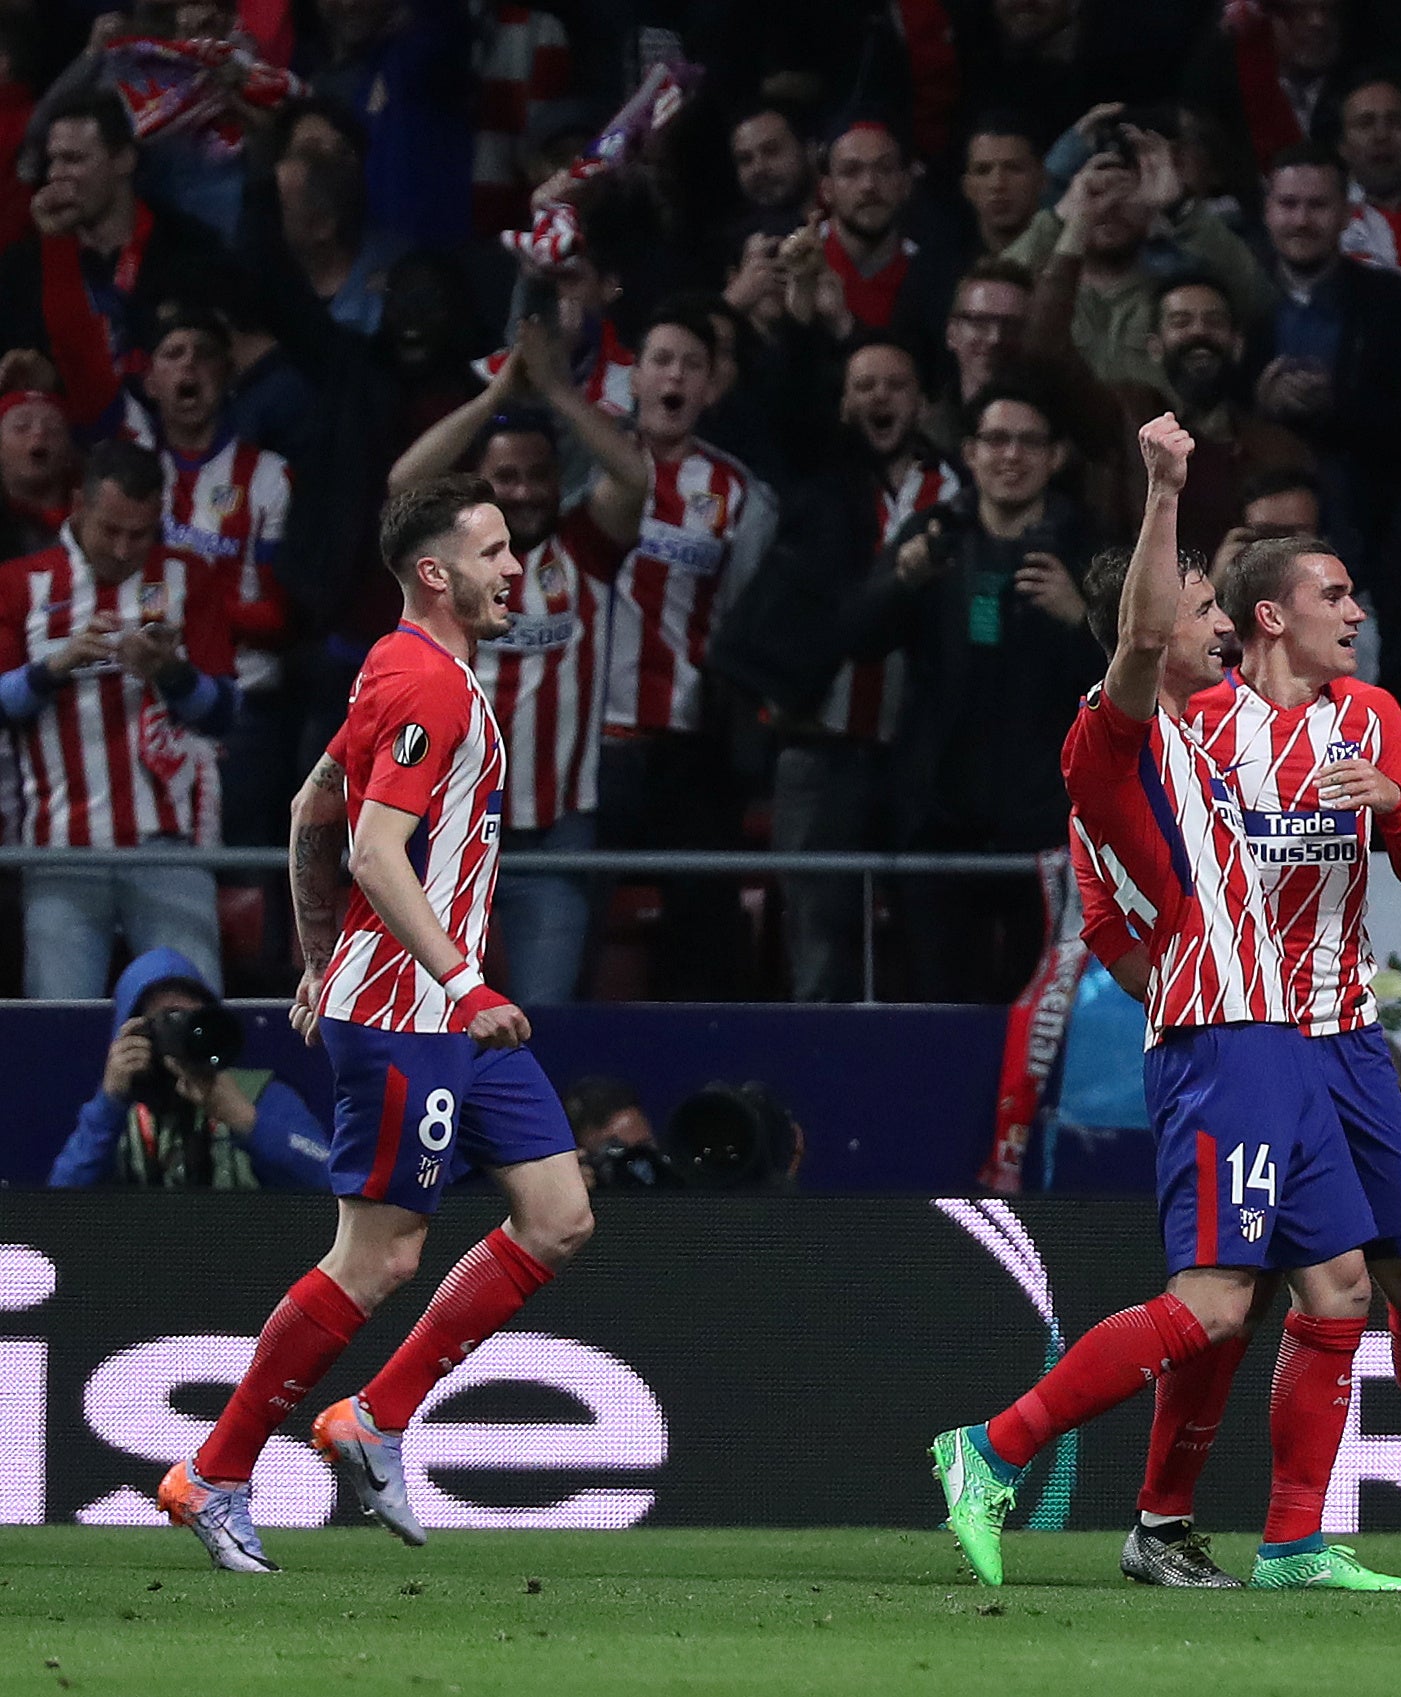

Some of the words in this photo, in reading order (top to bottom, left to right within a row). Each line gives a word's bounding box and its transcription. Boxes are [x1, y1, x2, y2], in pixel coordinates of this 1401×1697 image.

[1265, 812, 1336, 835] Trade
[418, 1087, 455, 1152] 8
[1225, 1142, 1276, 1207] 14
